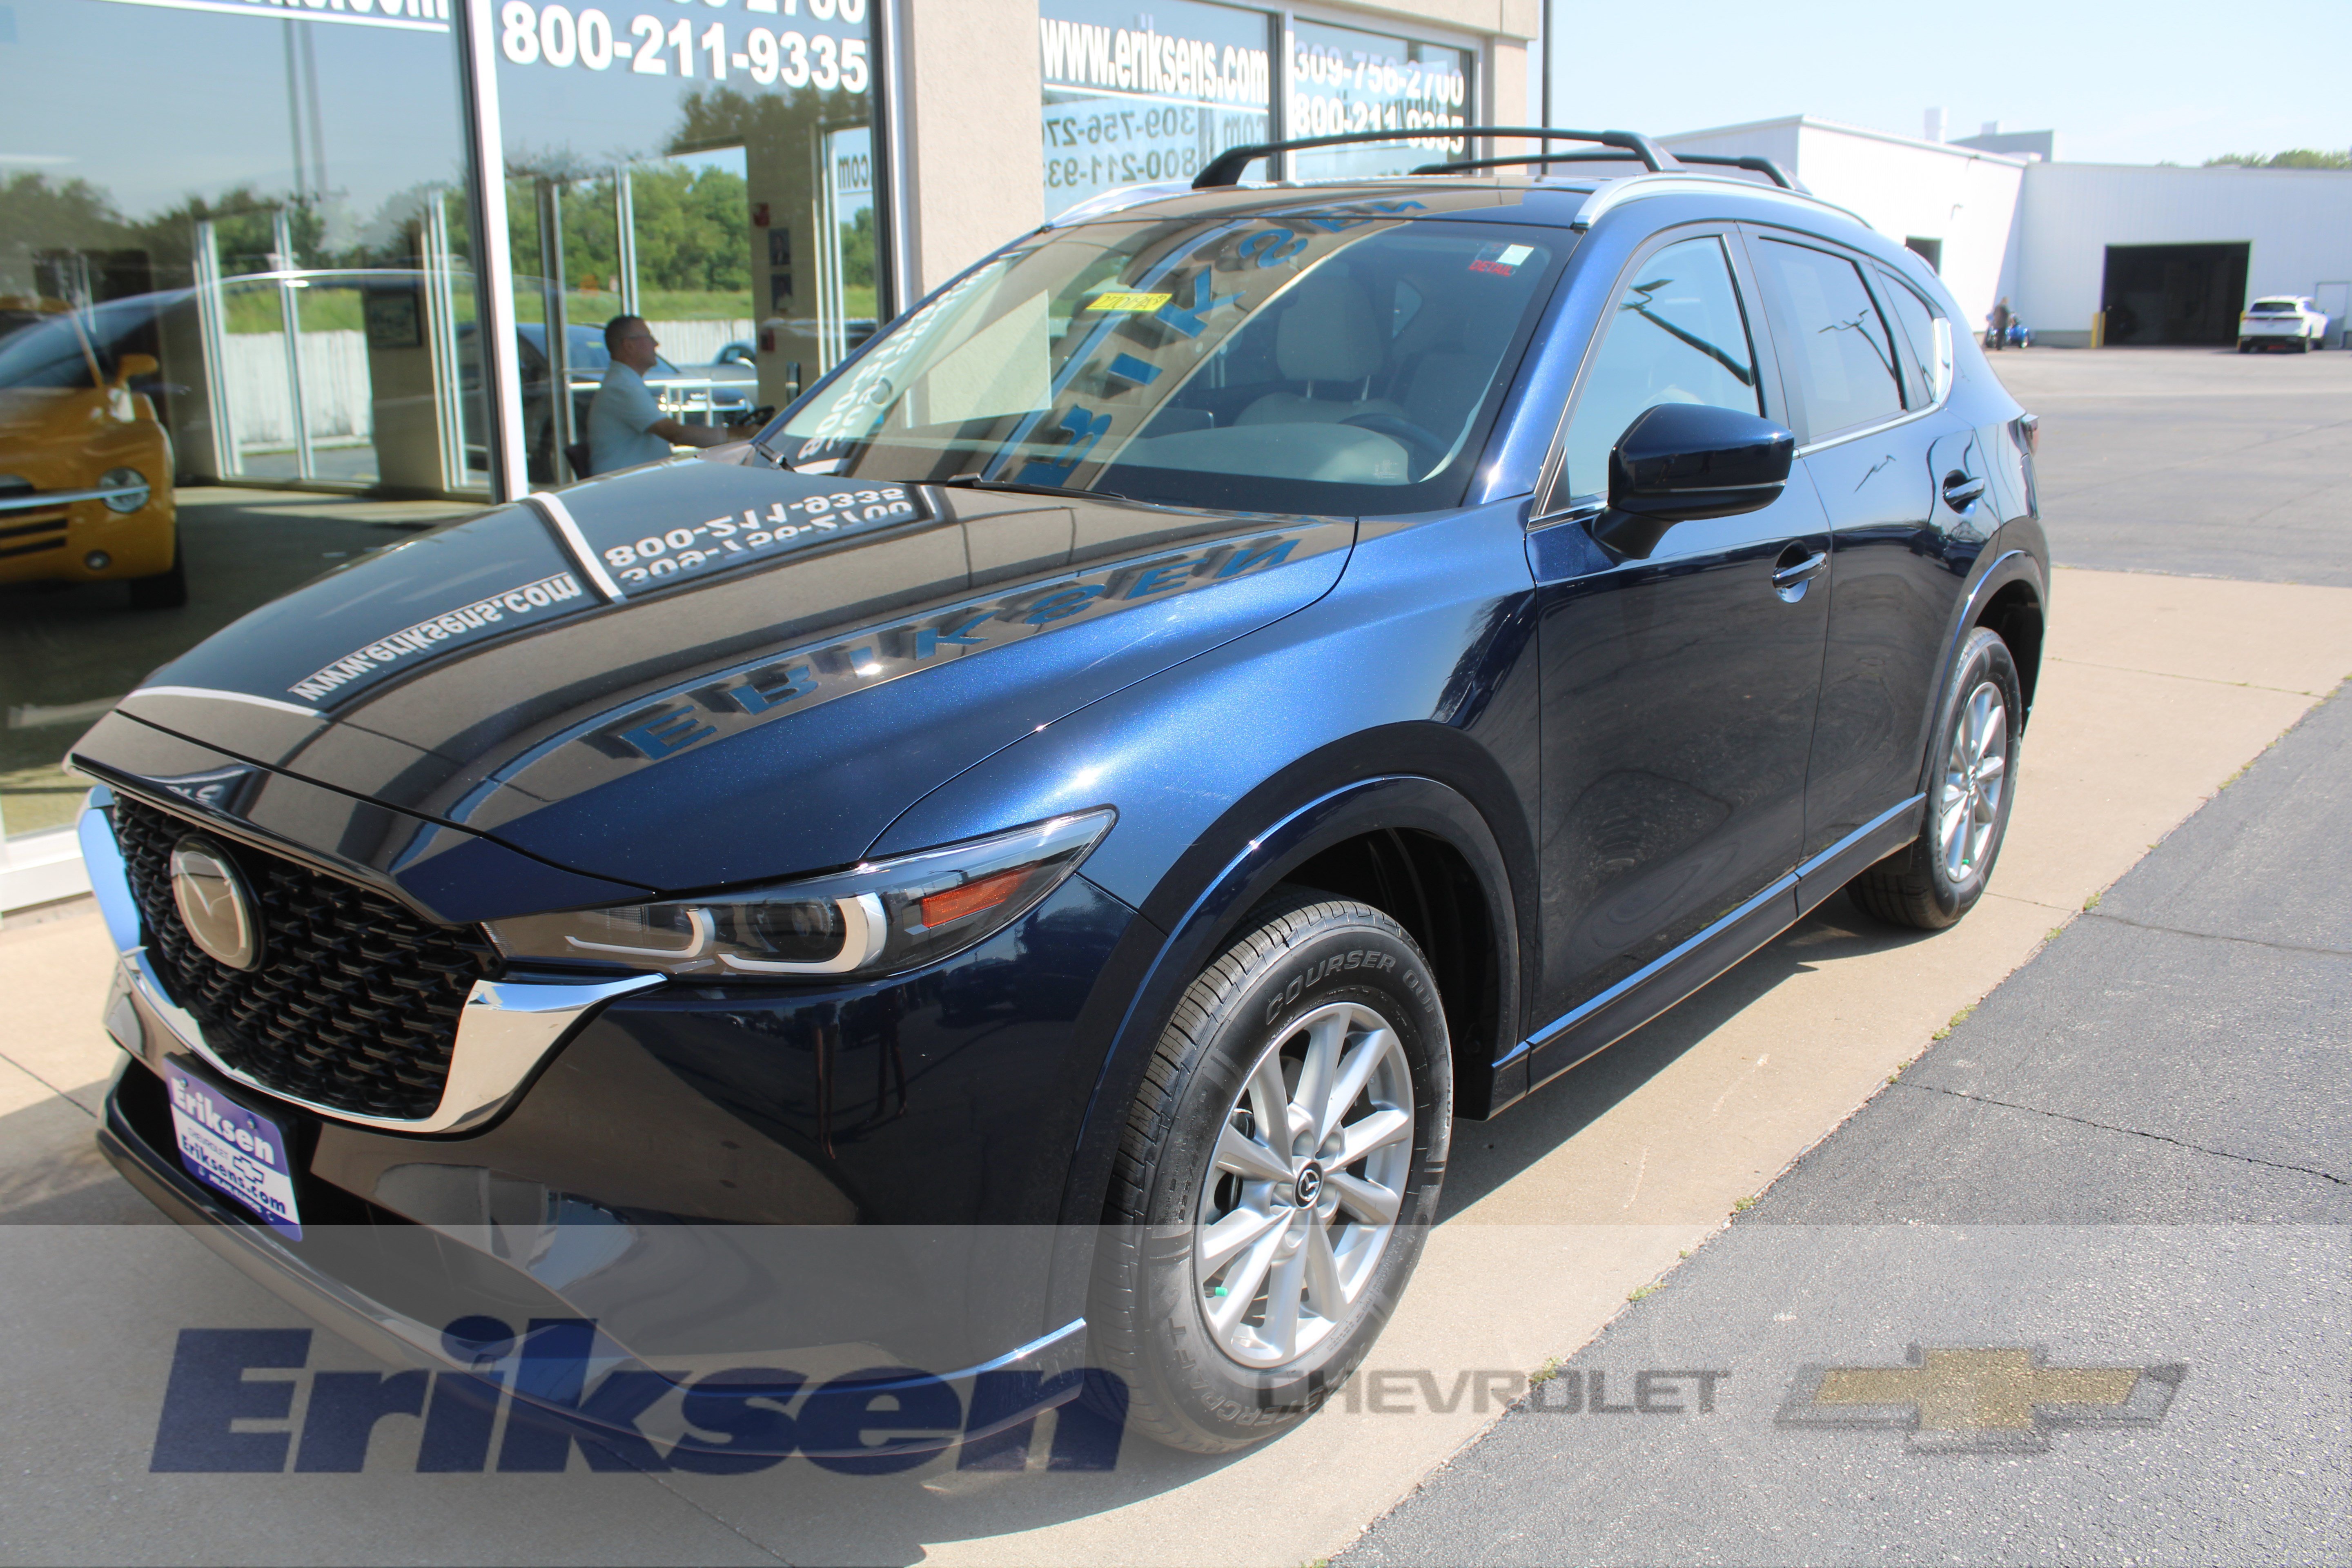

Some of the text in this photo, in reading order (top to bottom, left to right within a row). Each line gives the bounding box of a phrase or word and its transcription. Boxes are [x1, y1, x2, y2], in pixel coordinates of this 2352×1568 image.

[502, 0, 869, 94] 800-211-9335
[1040, 17, 1269, 104] www.eriksens.com
[1294, 40, 1465, 108] 309-756-2700
[1294, 92, 1465, 155] 800-2119335
[1468, 259, 1513, 277] DETAIL
[1266, 950, 1396, 1026] COURSER
[171, 1077, 275, 1165] Eriksen
[181, 1134, 287, 1216] Eriksens.com
